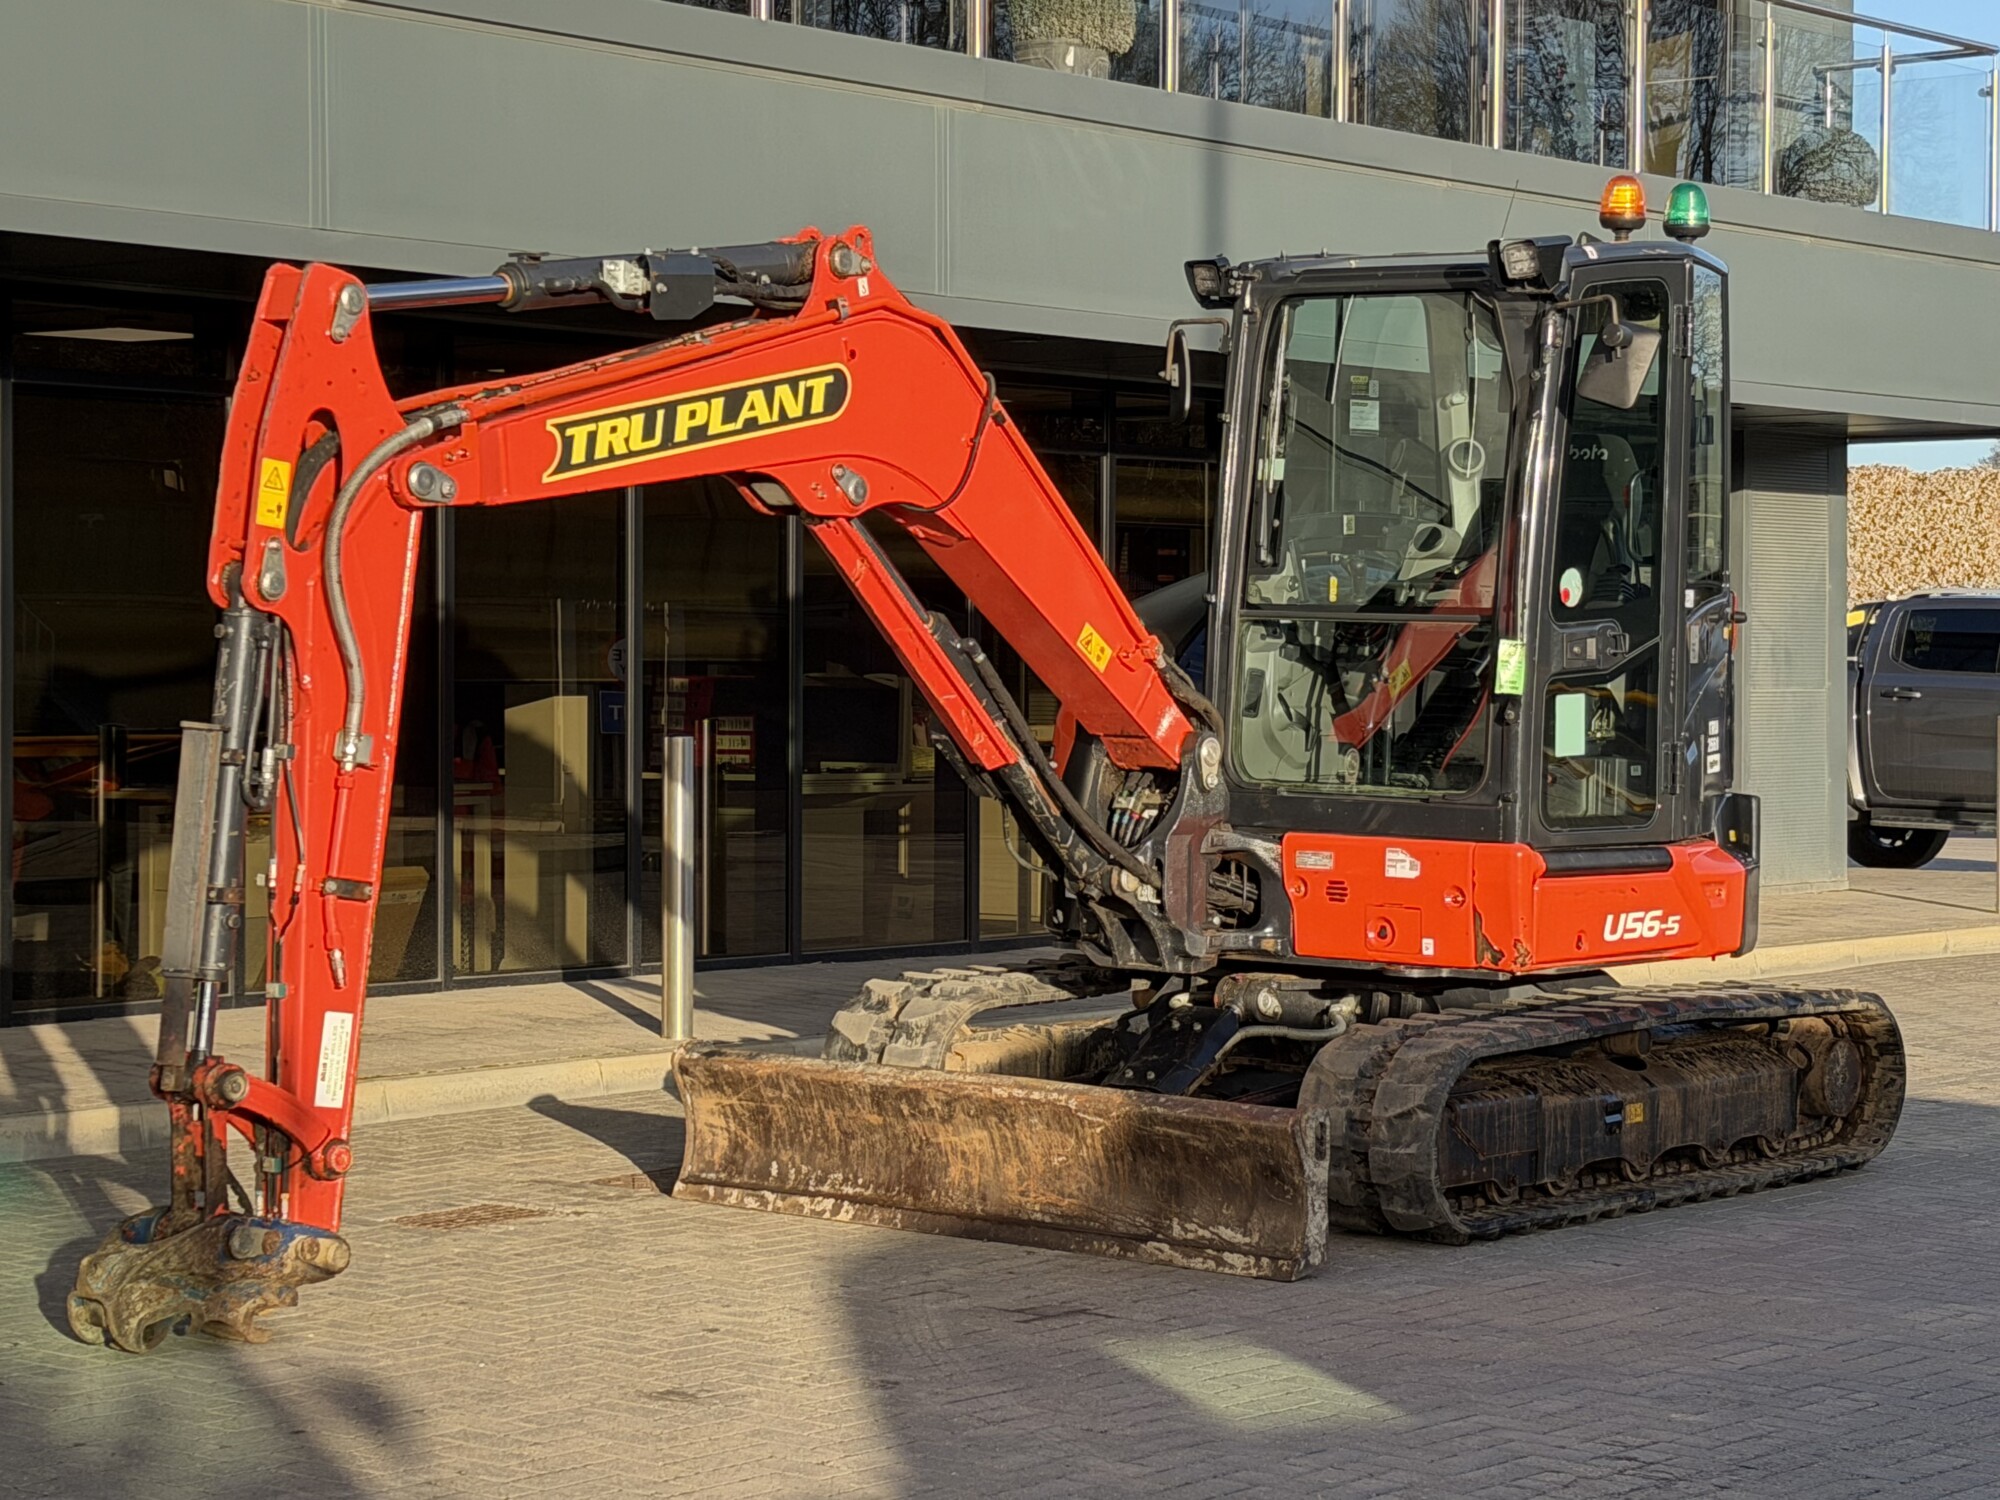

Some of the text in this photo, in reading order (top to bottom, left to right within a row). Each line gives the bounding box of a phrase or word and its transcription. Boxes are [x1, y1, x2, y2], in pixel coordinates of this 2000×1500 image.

[565, 375, 834, 465] TRU PLANT
[1569, 444, 1608, 460] bota
[1603, 909, 1681, 942] U56-5
